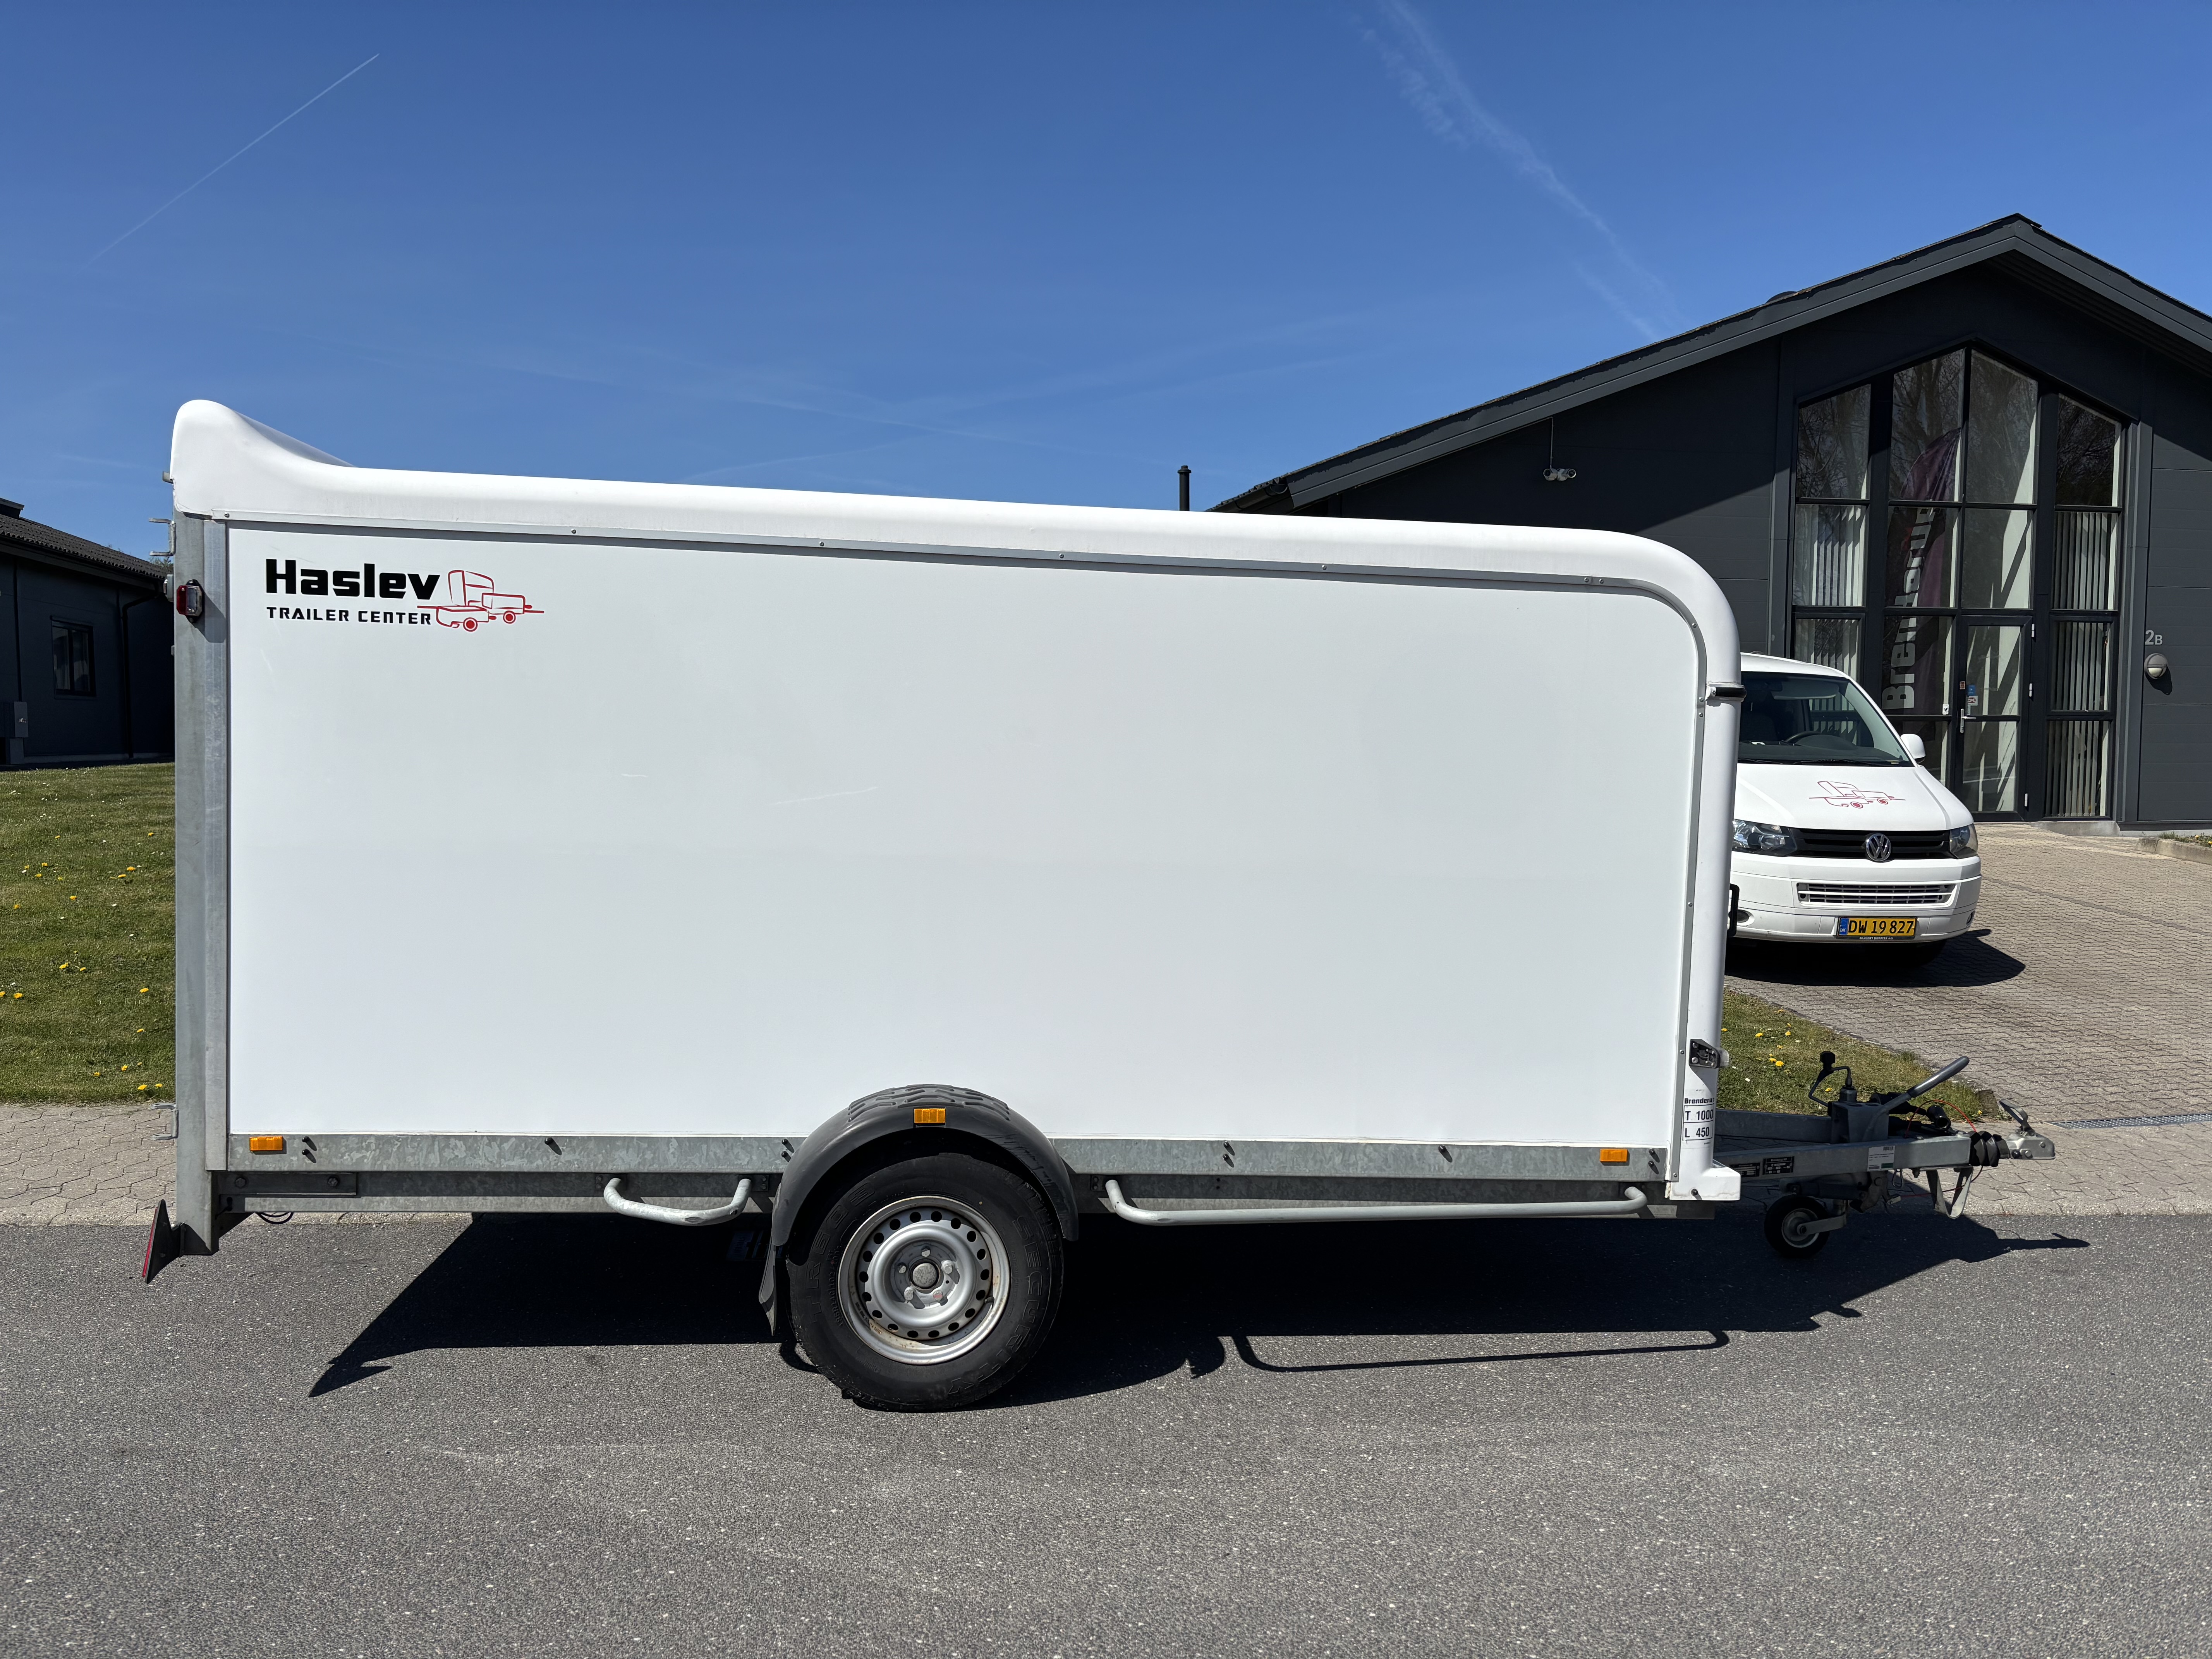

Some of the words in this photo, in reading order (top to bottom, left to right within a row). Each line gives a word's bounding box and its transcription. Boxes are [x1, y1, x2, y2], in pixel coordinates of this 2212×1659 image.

[266, 558, 441, 600] Haslev
[266, 606, 349, 622] TRAILER
[358, 610, 431, 625] CENTER
[2145, 629, 2163, 645] 2B
[1848, 920, 1868, 933] DW
[1871, 920, 1887, 934] 19
[1889, 920, 1914, 934] 827
[1685, 1111, 1691, 1121] T
[1696, 1109, 1714, 1121] 1000
[1685, 1127, 1690, 1138] L
[1696, 1127, 1710, 1137] 450
[947, 1215, 1044, 1395] SECURITY
